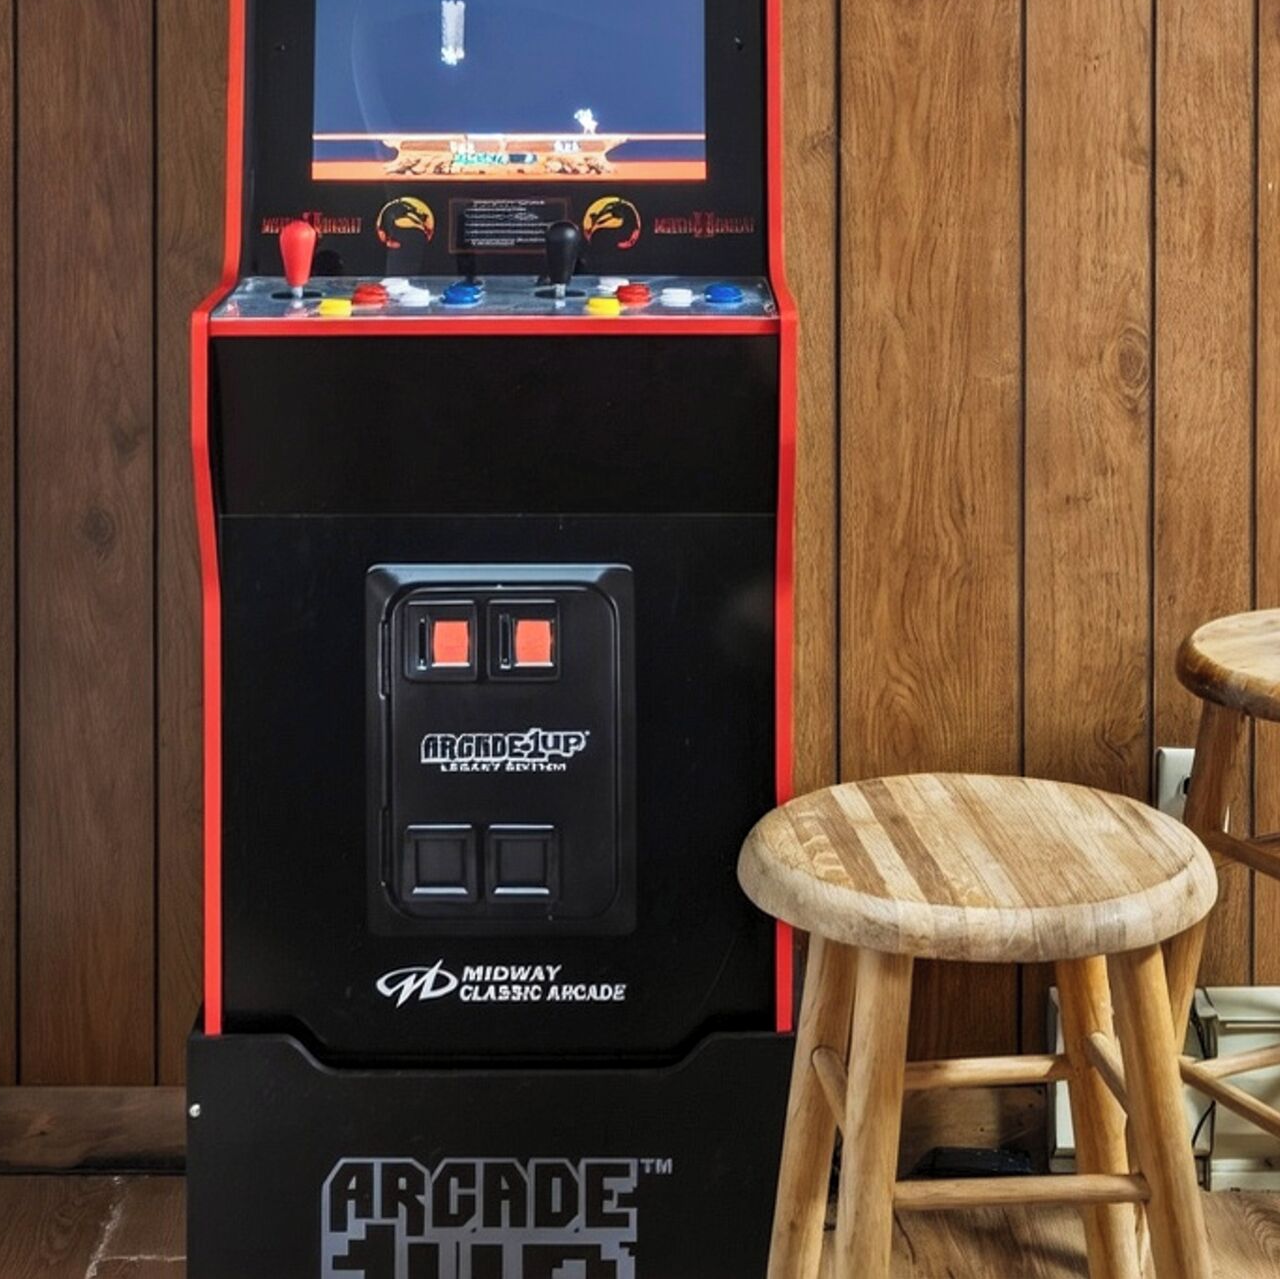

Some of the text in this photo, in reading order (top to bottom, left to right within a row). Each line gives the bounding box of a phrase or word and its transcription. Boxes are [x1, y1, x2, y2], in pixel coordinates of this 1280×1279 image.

[462, 965, 562, 982] MIDWAY
[459, 984, 627, 1002] CLASSIC ARCADE
[322, 1158, 637, 1237] ARCADE
